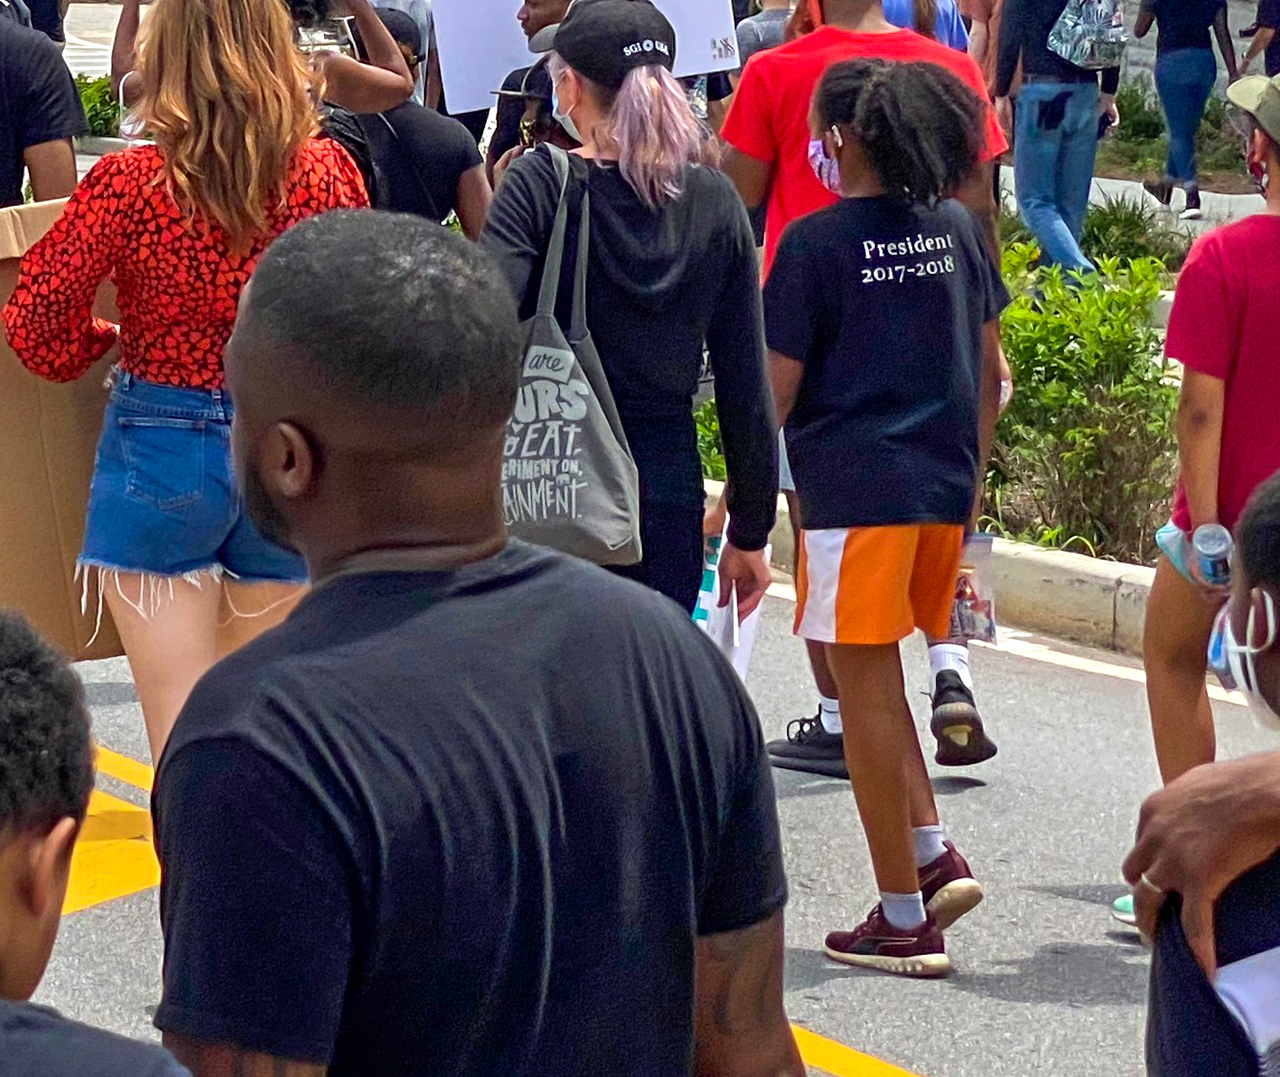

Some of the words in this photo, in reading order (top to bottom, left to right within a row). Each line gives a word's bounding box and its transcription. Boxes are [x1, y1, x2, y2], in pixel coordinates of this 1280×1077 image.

[623, 42, 643, 57] SGI
[861, 233, 955, 260] President
[860, 254, 956, 284] 2017-2018
[528, 353, 565, 372] are
[513, 378, 589, 423] URS
[501, 458, 560, 482] ERIMENT
[501, 477, 589, 524] AINMENT.
